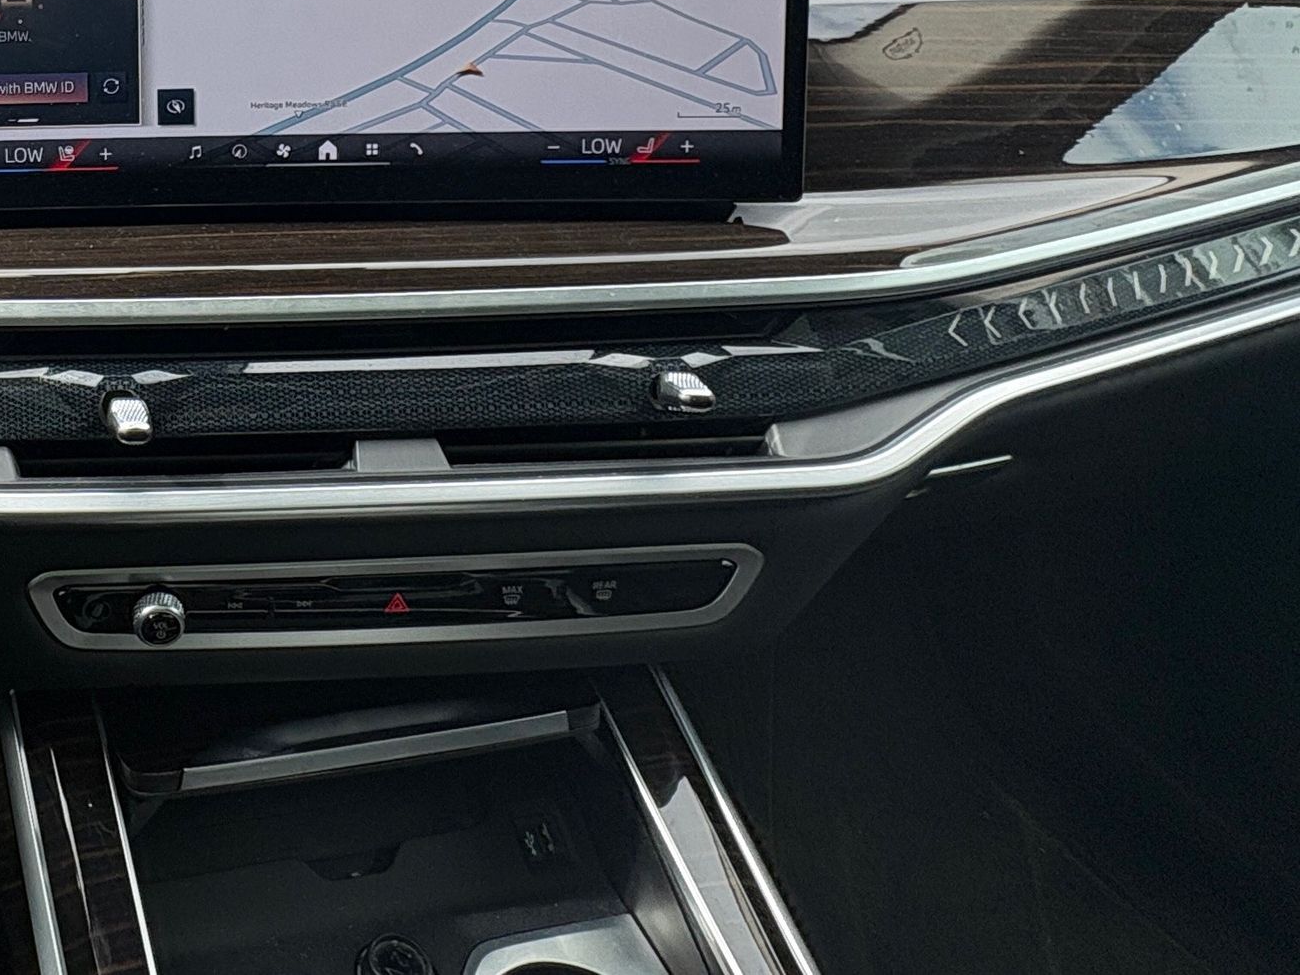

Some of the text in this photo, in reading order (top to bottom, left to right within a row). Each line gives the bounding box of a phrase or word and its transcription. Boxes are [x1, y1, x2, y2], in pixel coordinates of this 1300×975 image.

[24, 82, 58, 94] BMW
[61, 81, 74, 93] ID
[715, 102, 741, 114] 25 m
[581, 139, 622, 154] LOW
[5, 147, 44, 163] LOW
[502, 586, 523, 594] MAX
[592, 580, 617, 590] REAR
